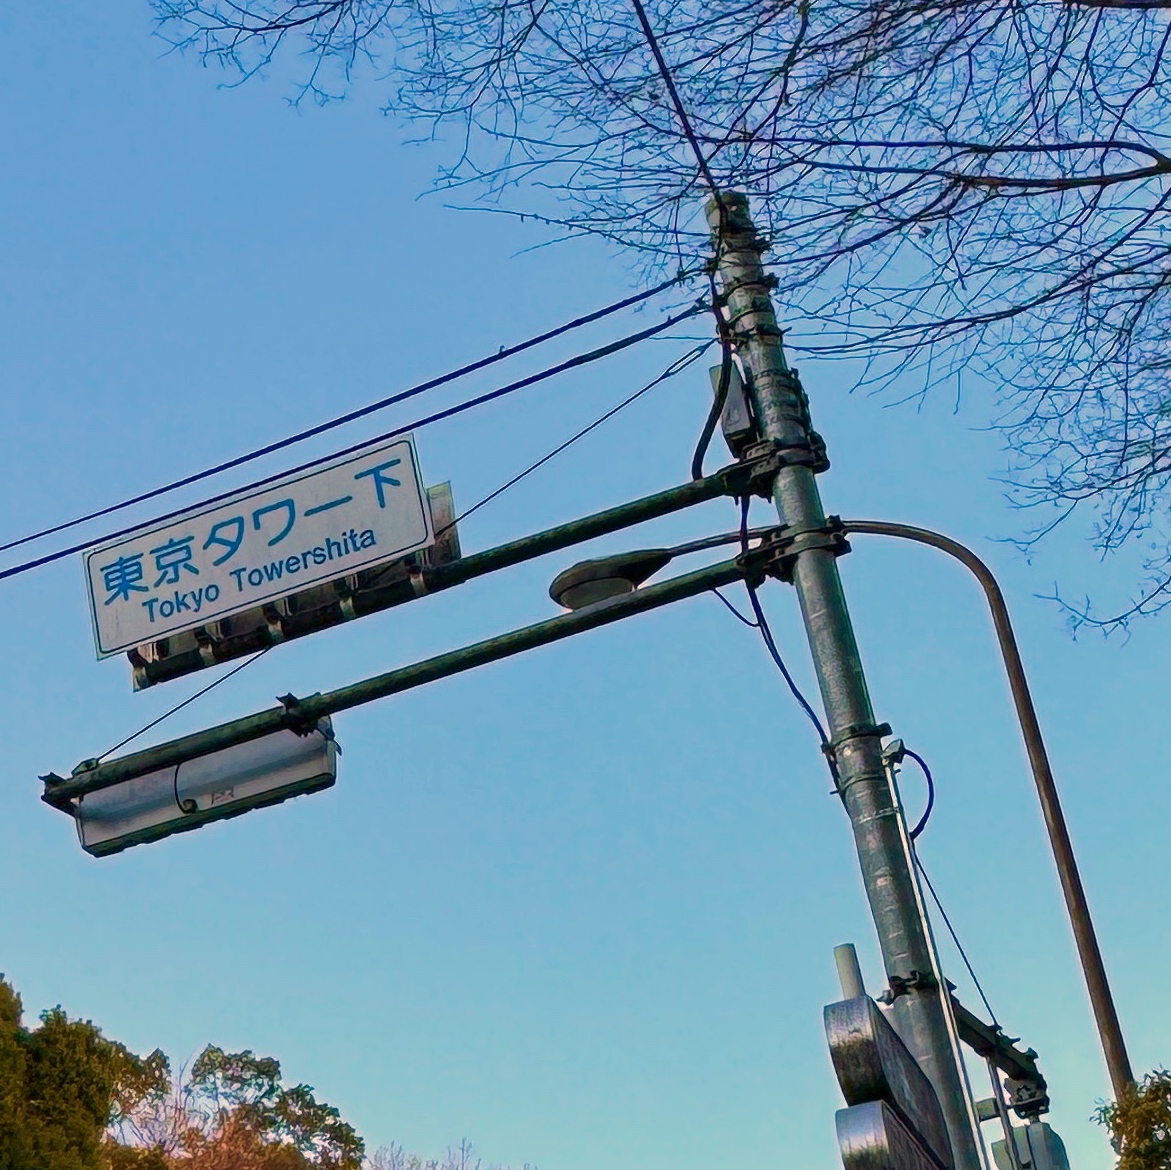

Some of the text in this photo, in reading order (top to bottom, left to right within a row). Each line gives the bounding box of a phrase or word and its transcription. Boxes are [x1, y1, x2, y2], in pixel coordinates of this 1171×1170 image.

[100, 459, 402, 606] 東京タワー下
[142, 528, 377, 622] Tokyo Towershita
